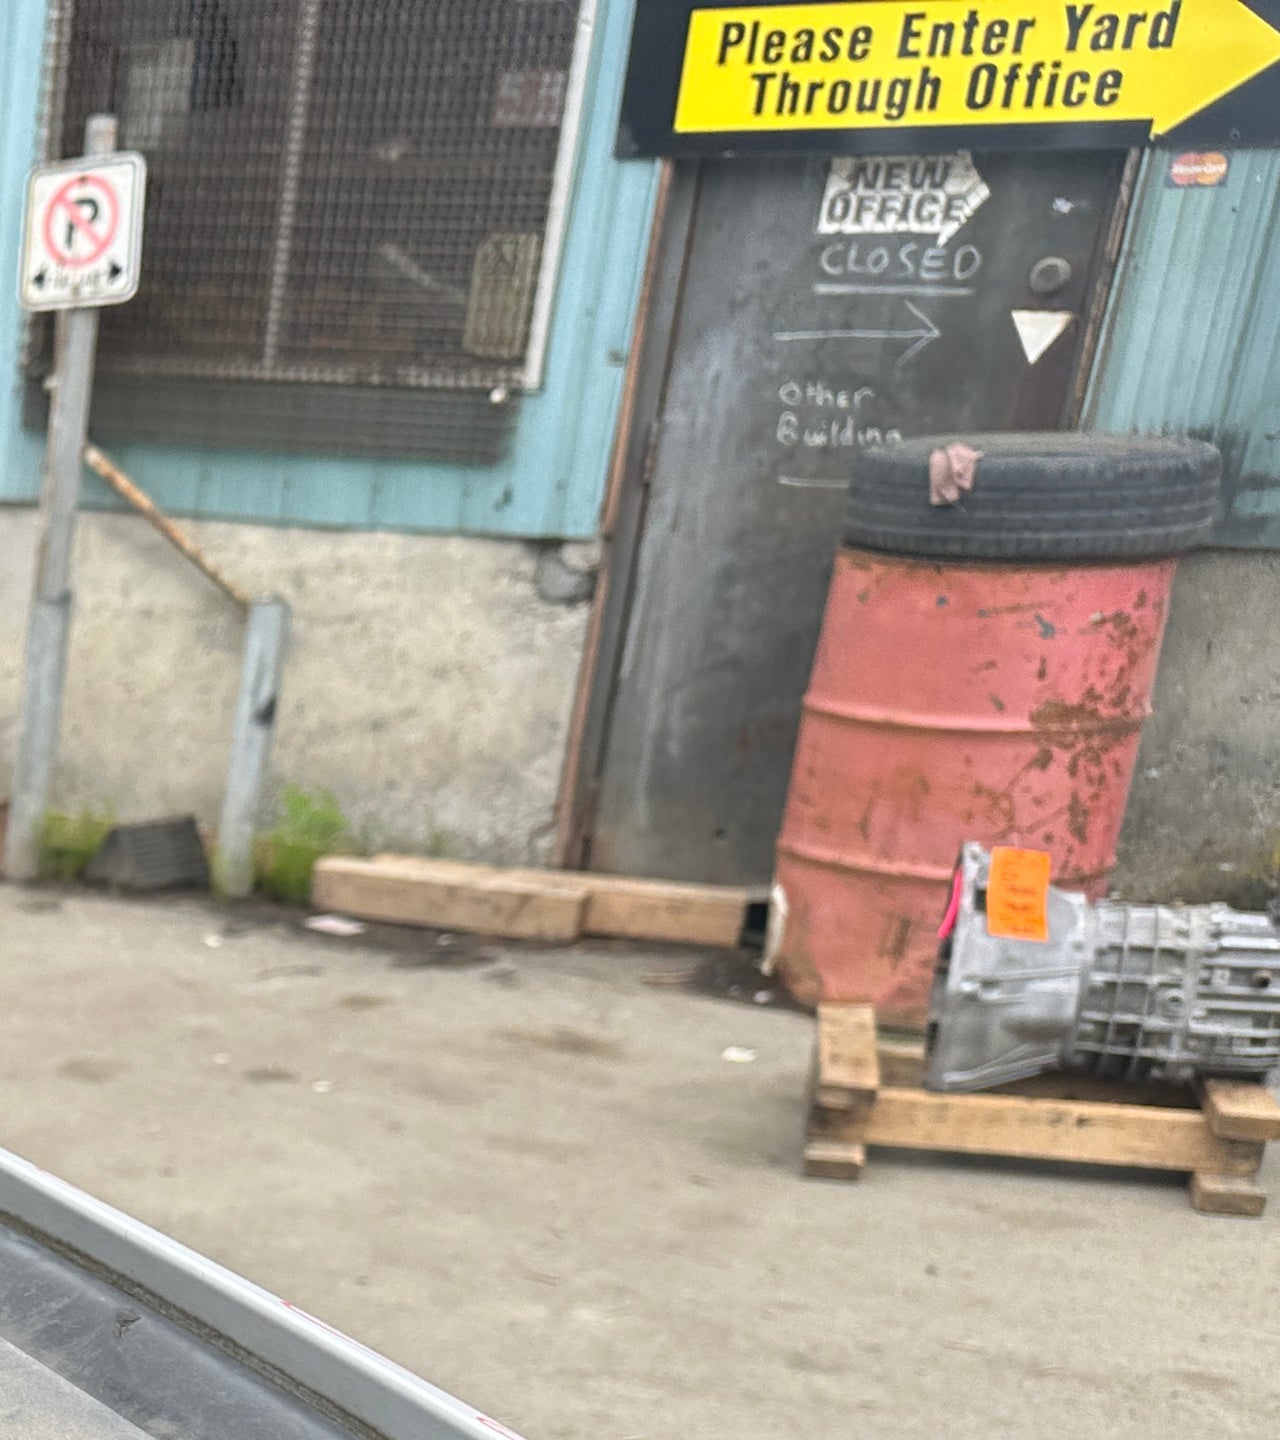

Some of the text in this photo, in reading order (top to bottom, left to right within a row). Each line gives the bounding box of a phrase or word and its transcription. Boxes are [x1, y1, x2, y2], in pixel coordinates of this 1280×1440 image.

[717, 0, 1182, 66] Please Enter Yard
[751, 60, 1124, 121] Through Office
[852, 161, 949, 190] NEW
[825, 192, 969, 225] OFFICE
[820, 240, 982, 280] CLOSED
[778, 380, 875, 409] Other
